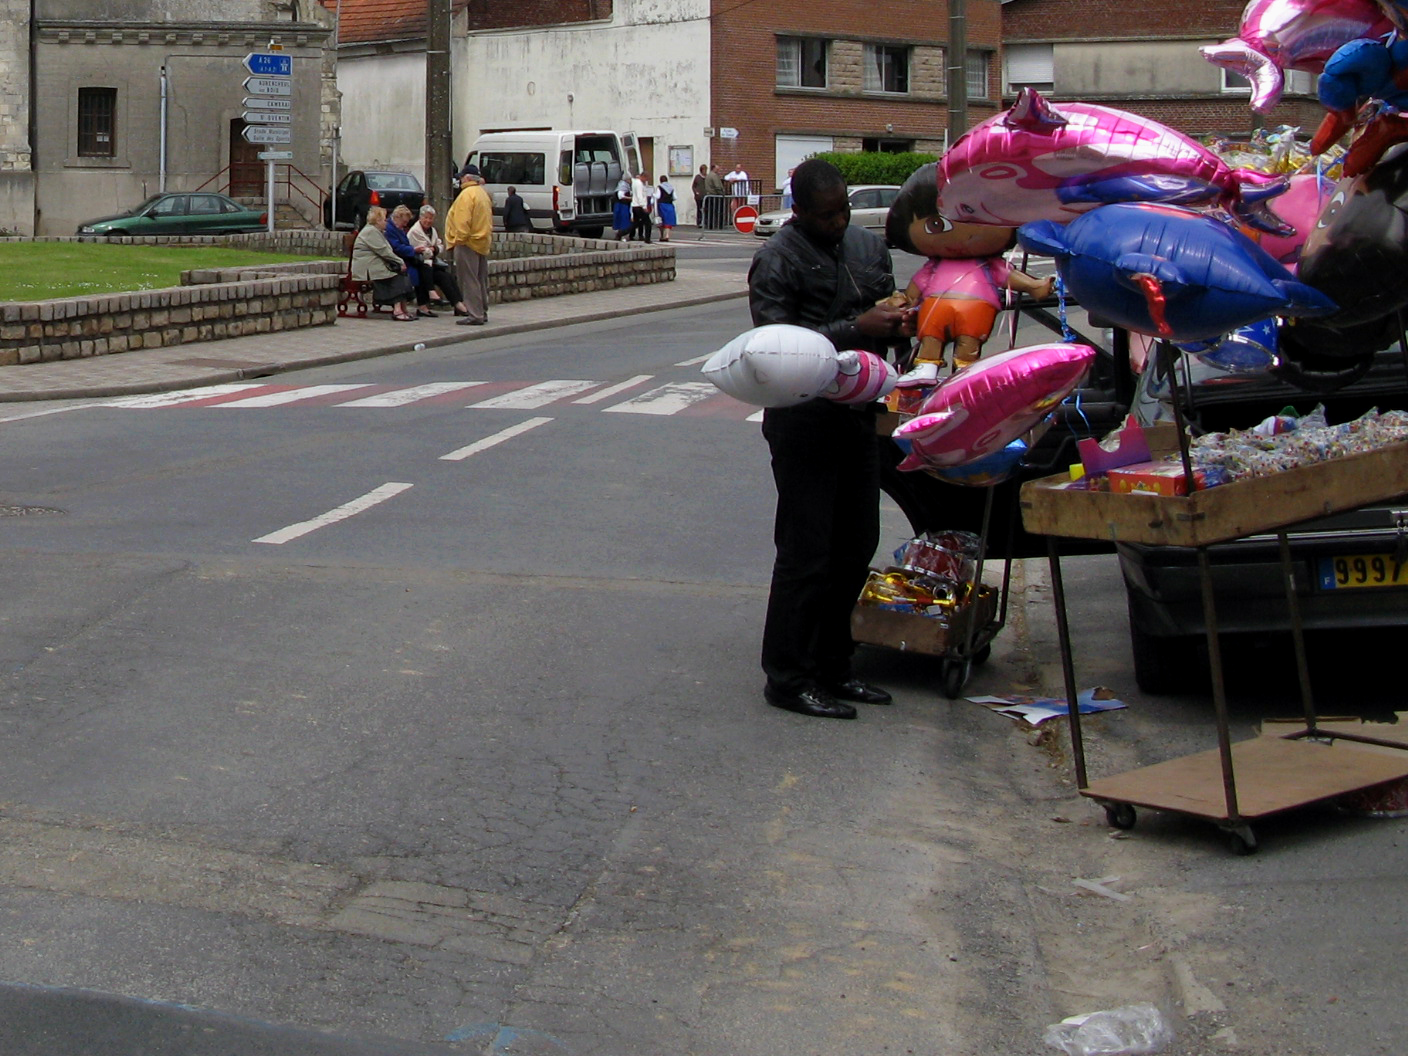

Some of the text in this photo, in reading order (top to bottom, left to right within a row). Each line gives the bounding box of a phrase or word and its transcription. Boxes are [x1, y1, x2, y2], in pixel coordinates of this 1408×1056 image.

[263, 56, 271, 64] 26
[1335, 556, 1403, 584] 9997
[1324, 576, 1330, 585] F
